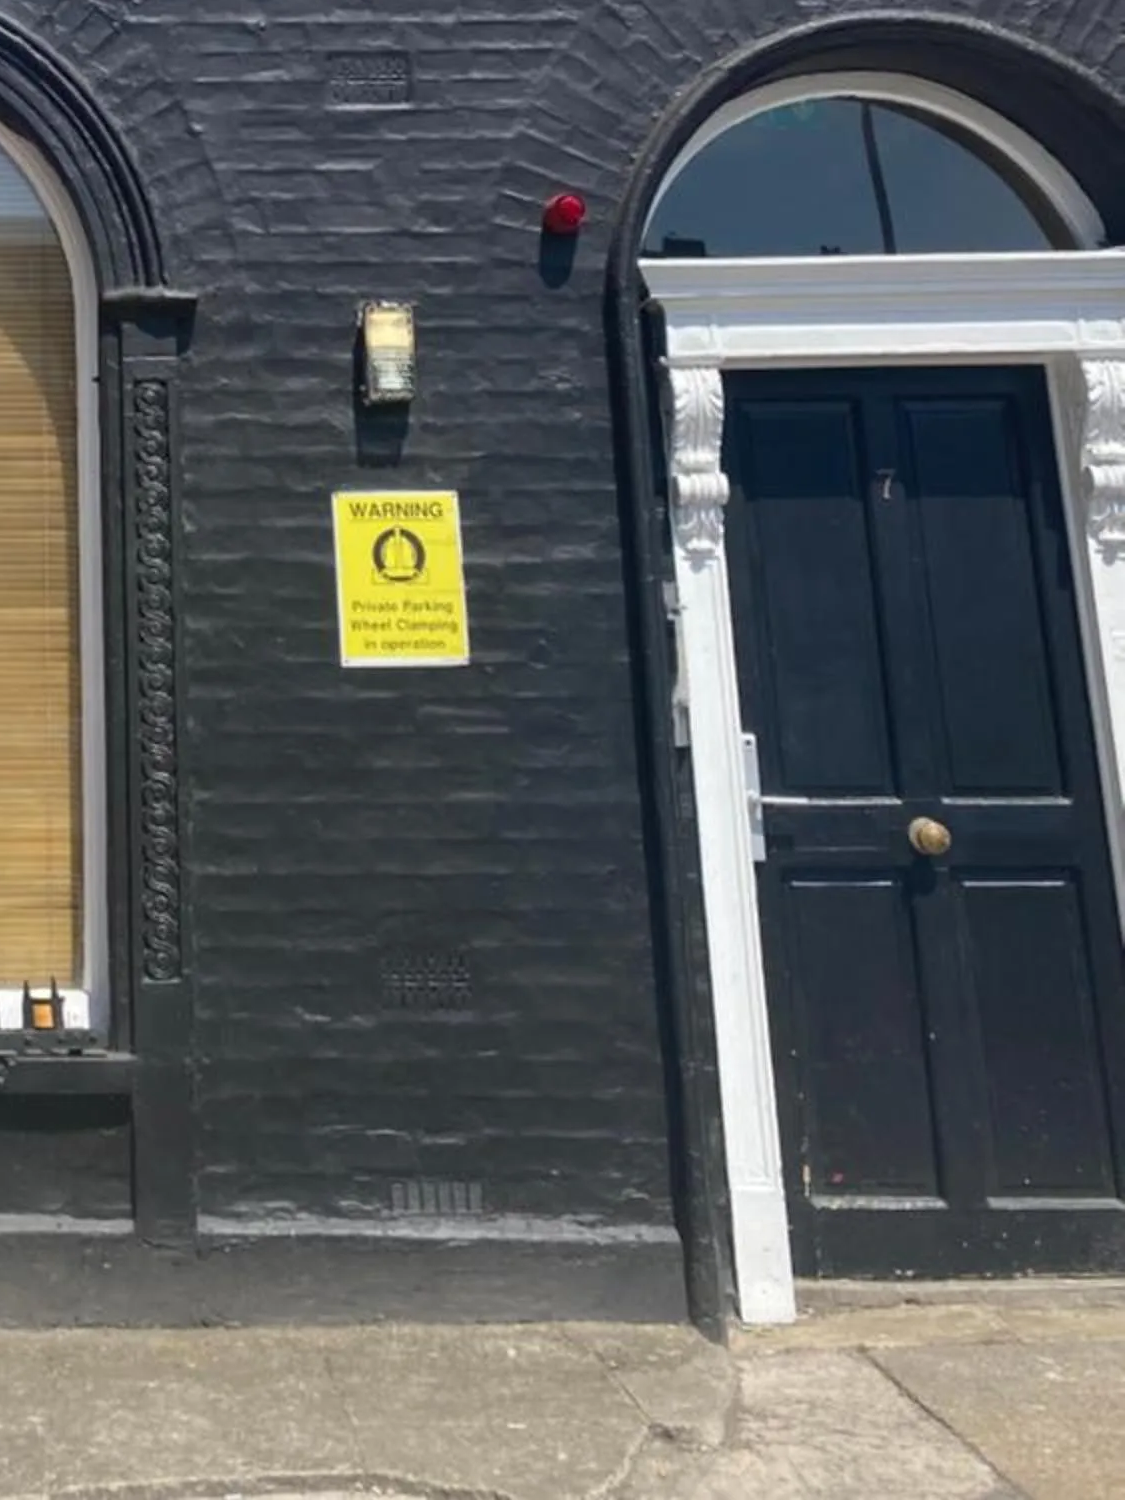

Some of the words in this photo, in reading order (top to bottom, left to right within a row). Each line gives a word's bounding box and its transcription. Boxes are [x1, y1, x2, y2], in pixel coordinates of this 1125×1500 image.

[876, 469, 895, 501] 7
[350, 502, 444, 519] WARNING
[351, 600, 398, 612] Private
[402, 600, 454, 614] Parking
[350, 618, 392, 632] Wheel
[396, 618, 458, 634] Clamping
[381, 638, 446, 652] operation
